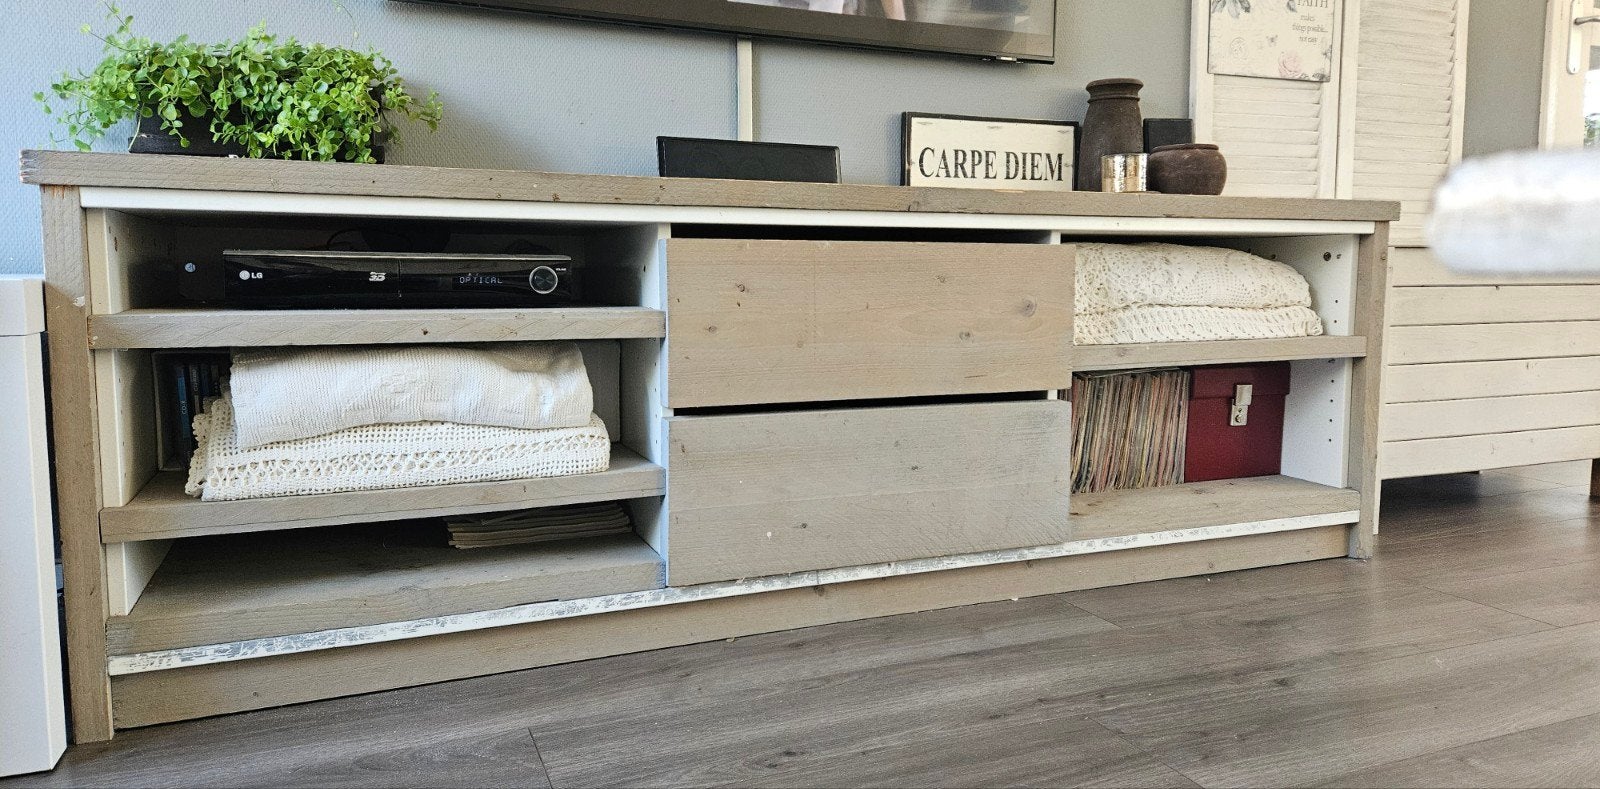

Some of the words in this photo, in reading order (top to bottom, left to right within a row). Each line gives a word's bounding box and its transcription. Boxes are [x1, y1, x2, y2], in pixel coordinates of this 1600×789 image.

[918, 146, 998, 179] CARPE
[1004, 151, 1064, 182] DIEM
[459, 276, 503, 284] OPTICAL
